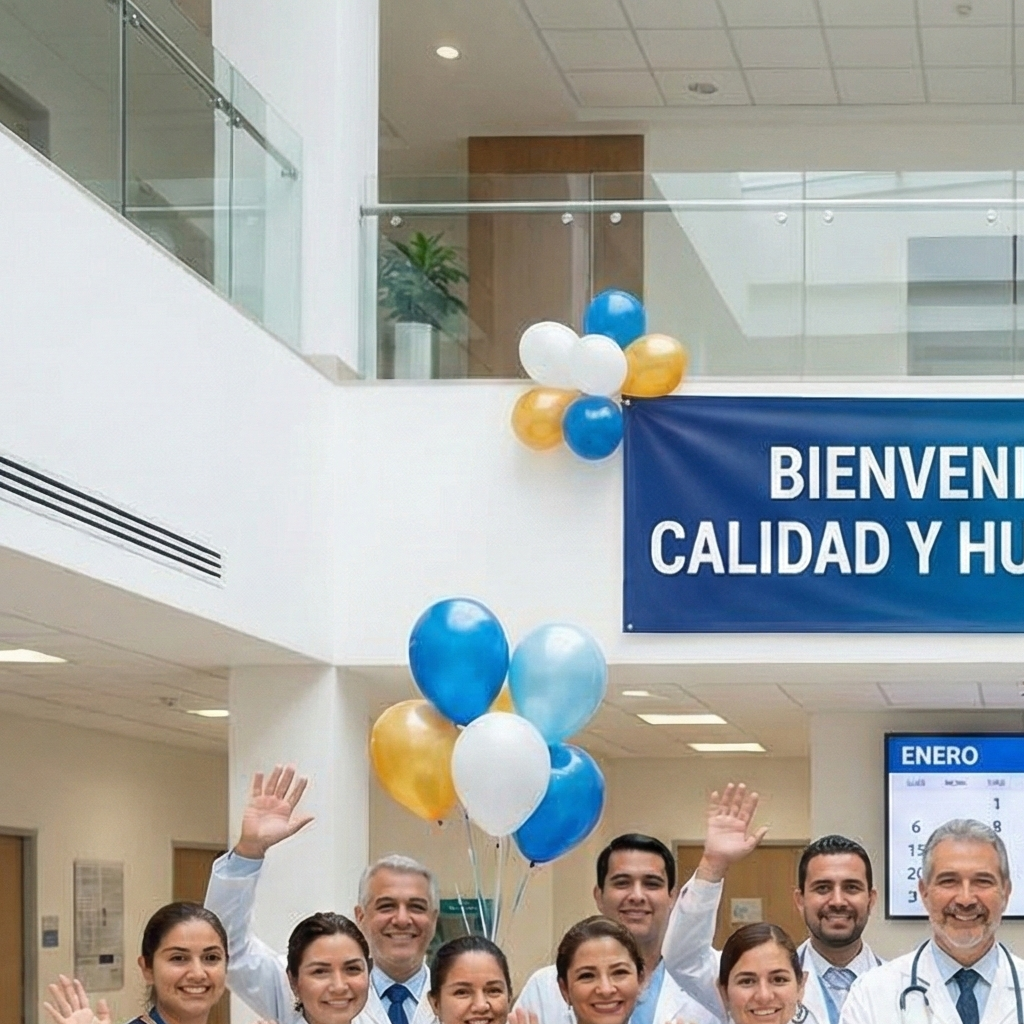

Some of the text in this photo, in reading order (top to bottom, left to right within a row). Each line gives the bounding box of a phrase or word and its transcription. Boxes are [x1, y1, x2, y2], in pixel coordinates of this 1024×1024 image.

[650, 520, 890, 574] CALIDAD
[906, 521, 942, 573] Y
[901, 746, 979, 765] ENERO
[993, 797, 1000, 810] 1
[911, 820, 921, 834] 6
[993, 820, 1002, 833] 8
[908, 844, 927, 857] 15
